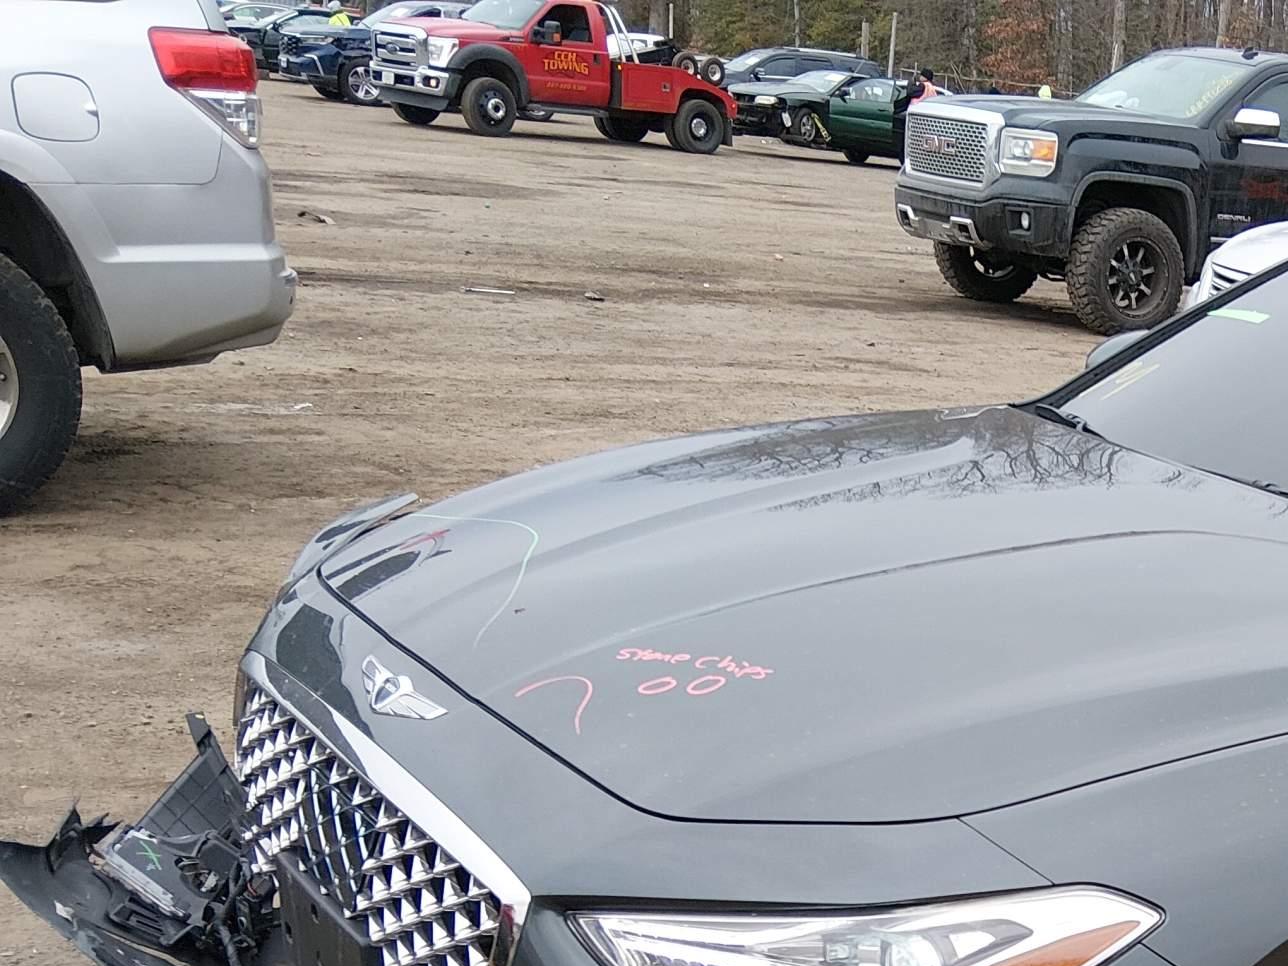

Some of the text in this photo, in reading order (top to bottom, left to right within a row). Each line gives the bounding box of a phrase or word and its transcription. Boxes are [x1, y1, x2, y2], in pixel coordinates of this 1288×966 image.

[543, 59, 589, 75] TOWING
[922, 134, 957, 155] GMC
[1216, 213, 1251, 222] DENALI
